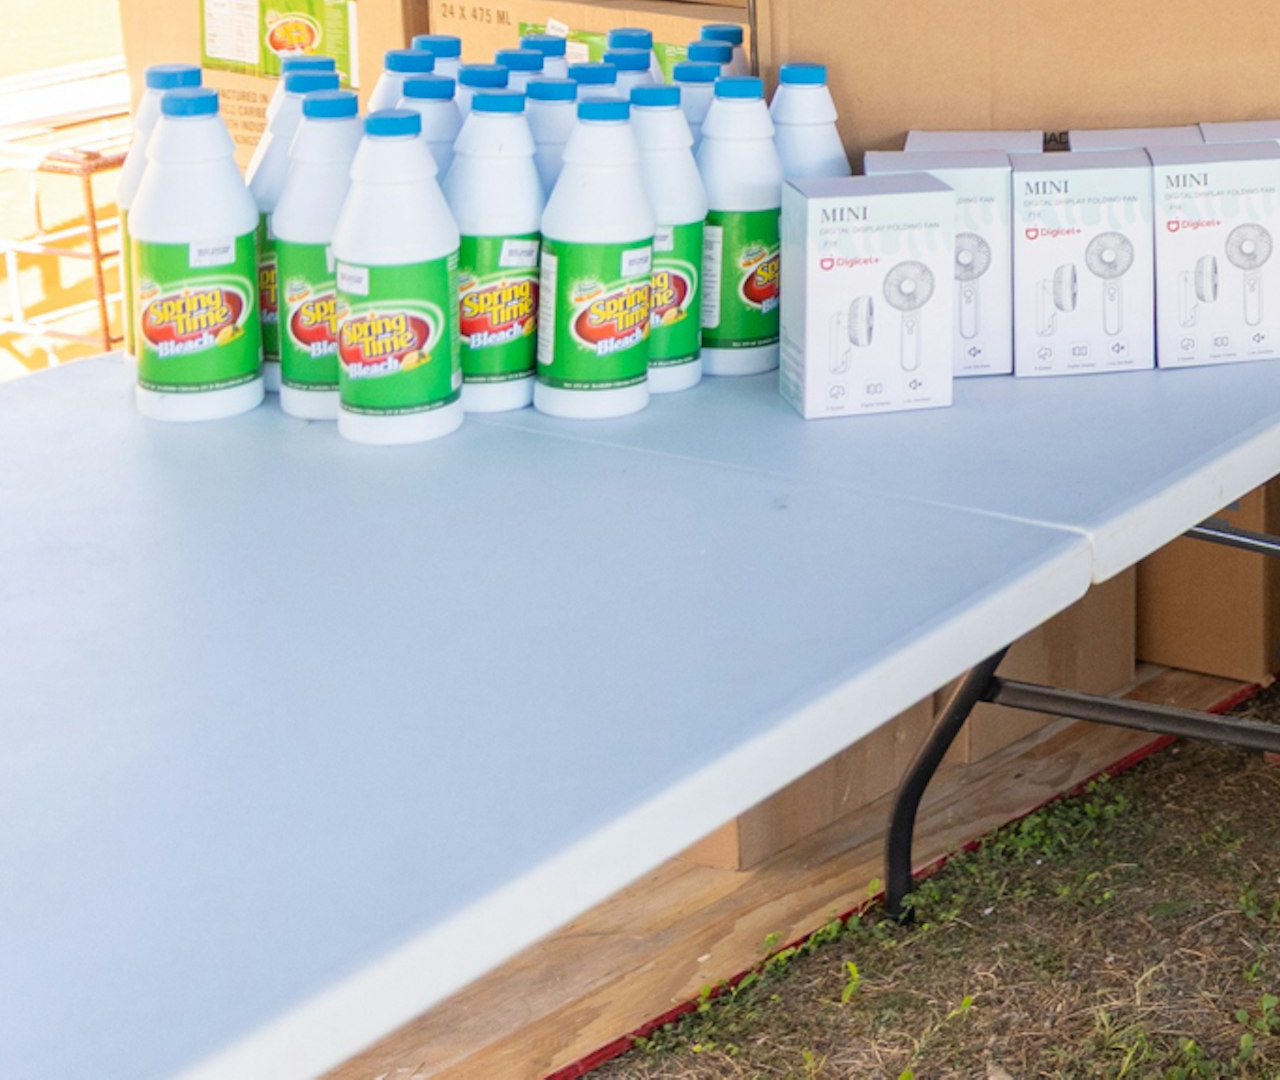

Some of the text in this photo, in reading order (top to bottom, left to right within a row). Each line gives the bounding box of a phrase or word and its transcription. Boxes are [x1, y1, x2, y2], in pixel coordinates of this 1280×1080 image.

[442, 3, 512, 26] 24 X 475 ML
[1025, 180, 1068, 195] MINI
[1166, 173, 1208, 188] MINI
[1088, 196, 1121, 204] FOLDING
[822, 206, 868, 223] MINI
[1181, 219, 1221, 230] Digicel+
[853, 224, 885, 233] DISPLAY
[887, 223, 922, 231] FOLDING
[1041, 227, 1082, 238] Digicel+
[836, 256, 880, 268] Digicel+
[150, 288, 223, 325] Spring
[302, 296, 337, 326] Spr
[463, 280, 532, 318] Spring
[489, 297, 534, 325] Time
[589, 285, 650, 325] Spring
[174, 307, 230, 335] Time
[343, 312, 408, 345] Spring
[158, 332, 216, 358] Bleach
[362, 330, 416, 358] Time
[470, 322, 522, 350] Bleach
[597, 328, 644, 356] Bleach
[311, 340, 338, 359] Ble
[350, 357, 400, 378] Bleach
